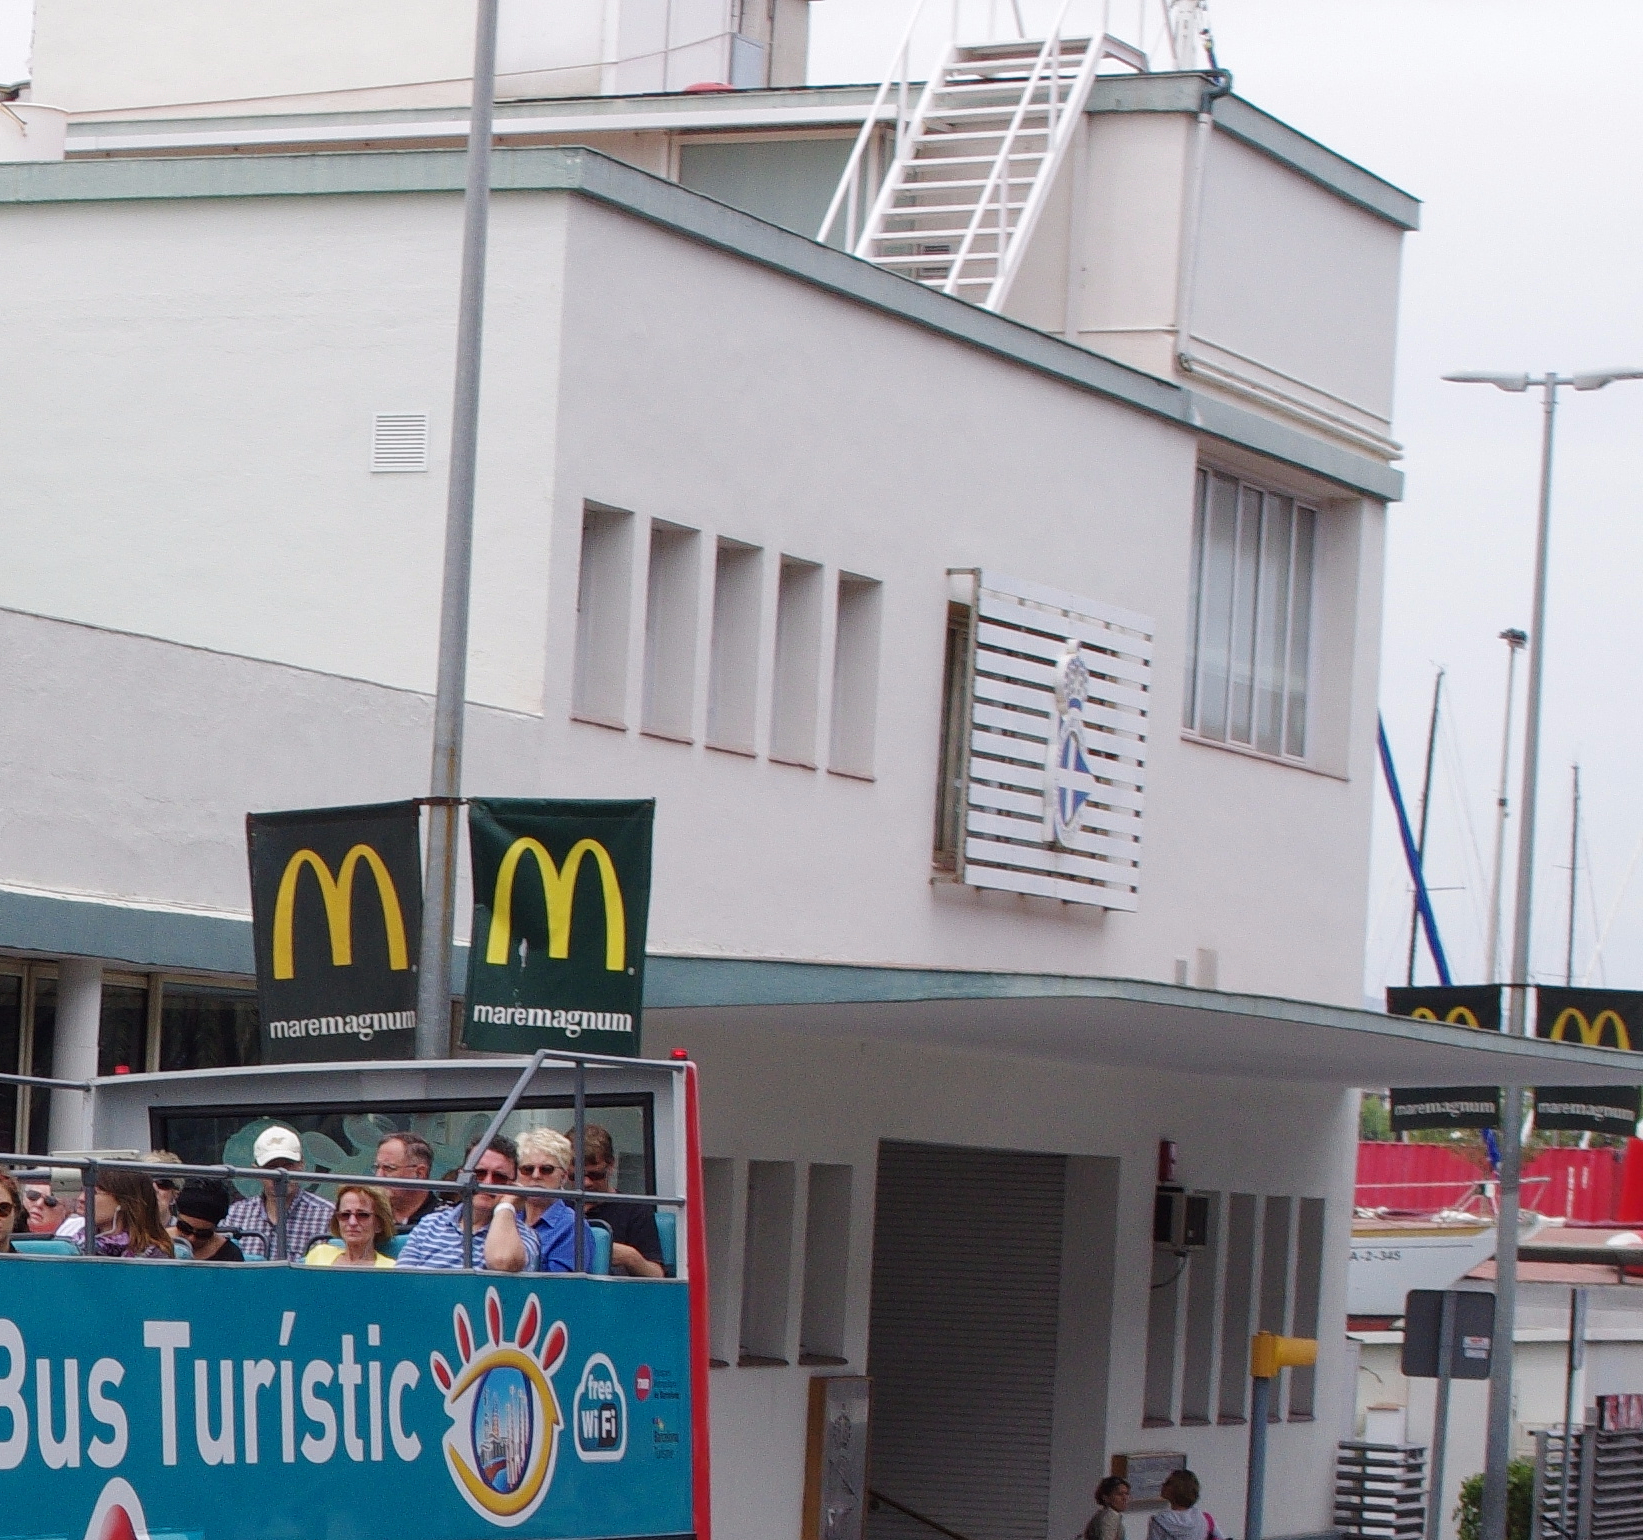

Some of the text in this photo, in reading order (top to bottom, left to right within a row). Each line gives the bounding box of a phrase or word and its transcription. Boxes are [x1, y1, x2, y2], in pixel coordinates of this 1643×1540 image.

[269, 1009, 416, 1041] maremagnum
[473, 1003, 633, 1039] maremagnum
[1395, 1101, 1496, 1119] maremagnum
[1538, 1101, 1637, 1122] maremagnum
[143, 1310, 422, 1465] Turístic
[588, 1374, 613, 1400] free
